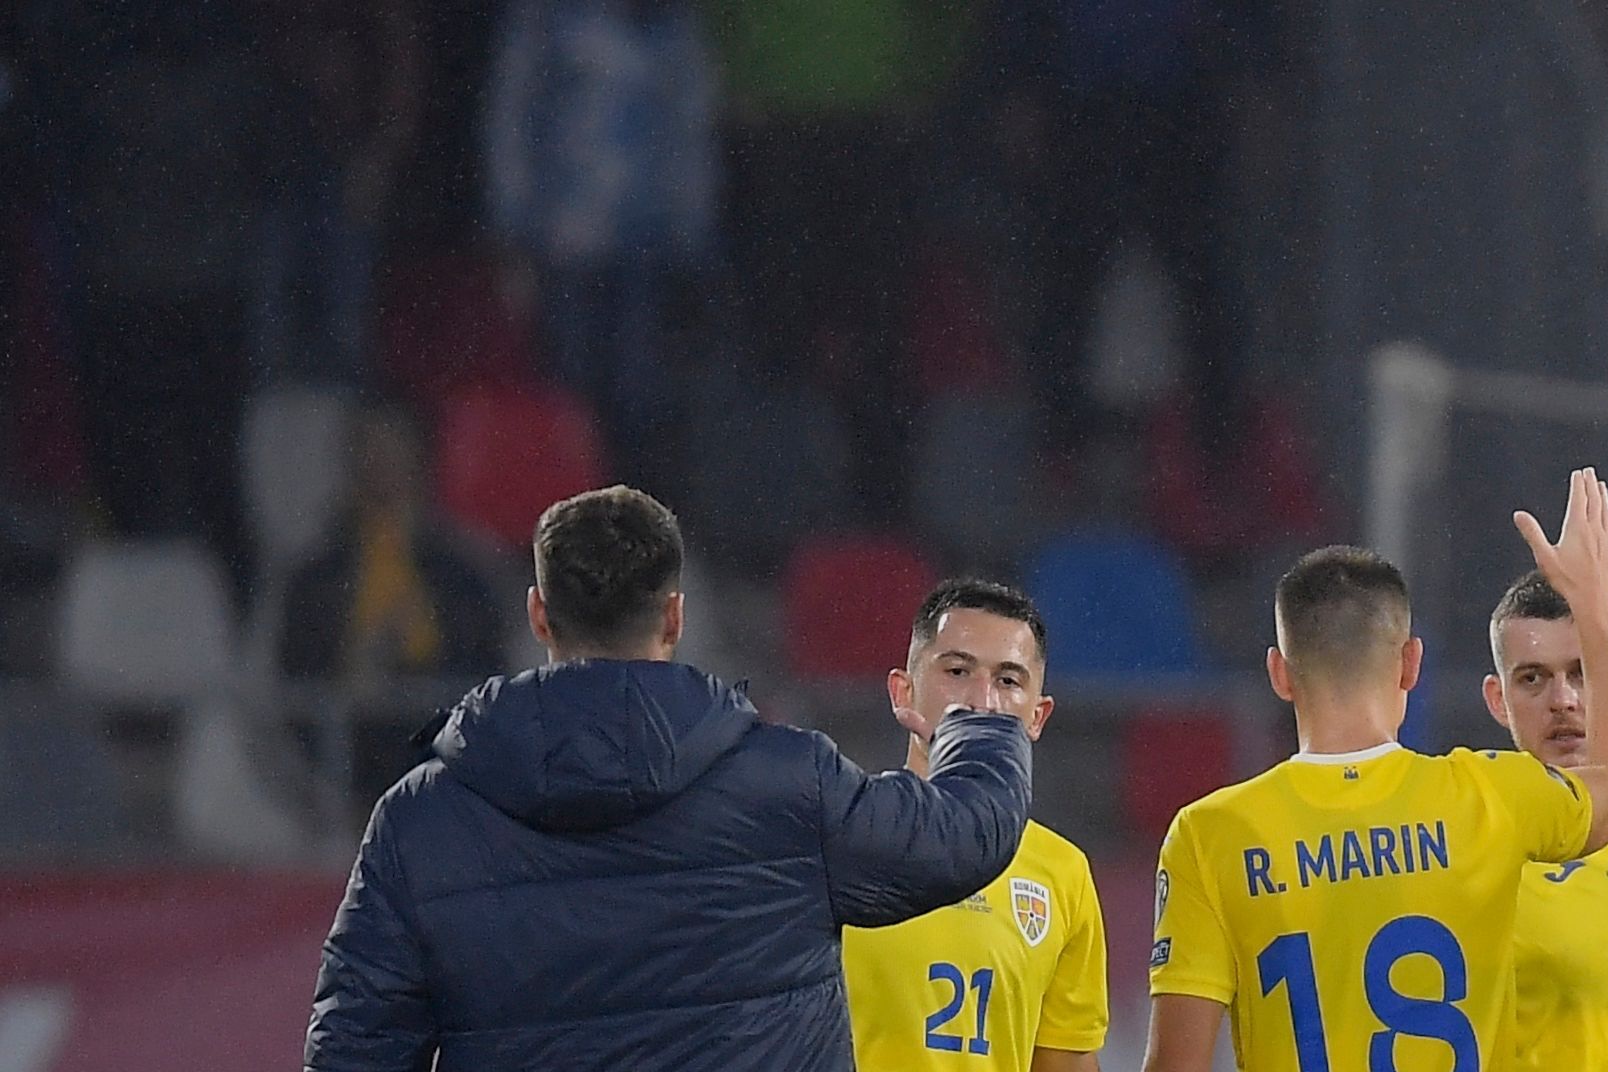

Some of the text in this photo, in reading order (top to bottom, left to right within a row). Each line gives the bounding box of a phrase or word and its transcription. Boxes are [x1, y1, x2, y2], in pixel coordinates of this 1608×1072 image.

[1245, 822, 1449, 897] R. MARIN
[925, 962, 994, 1056] 21
